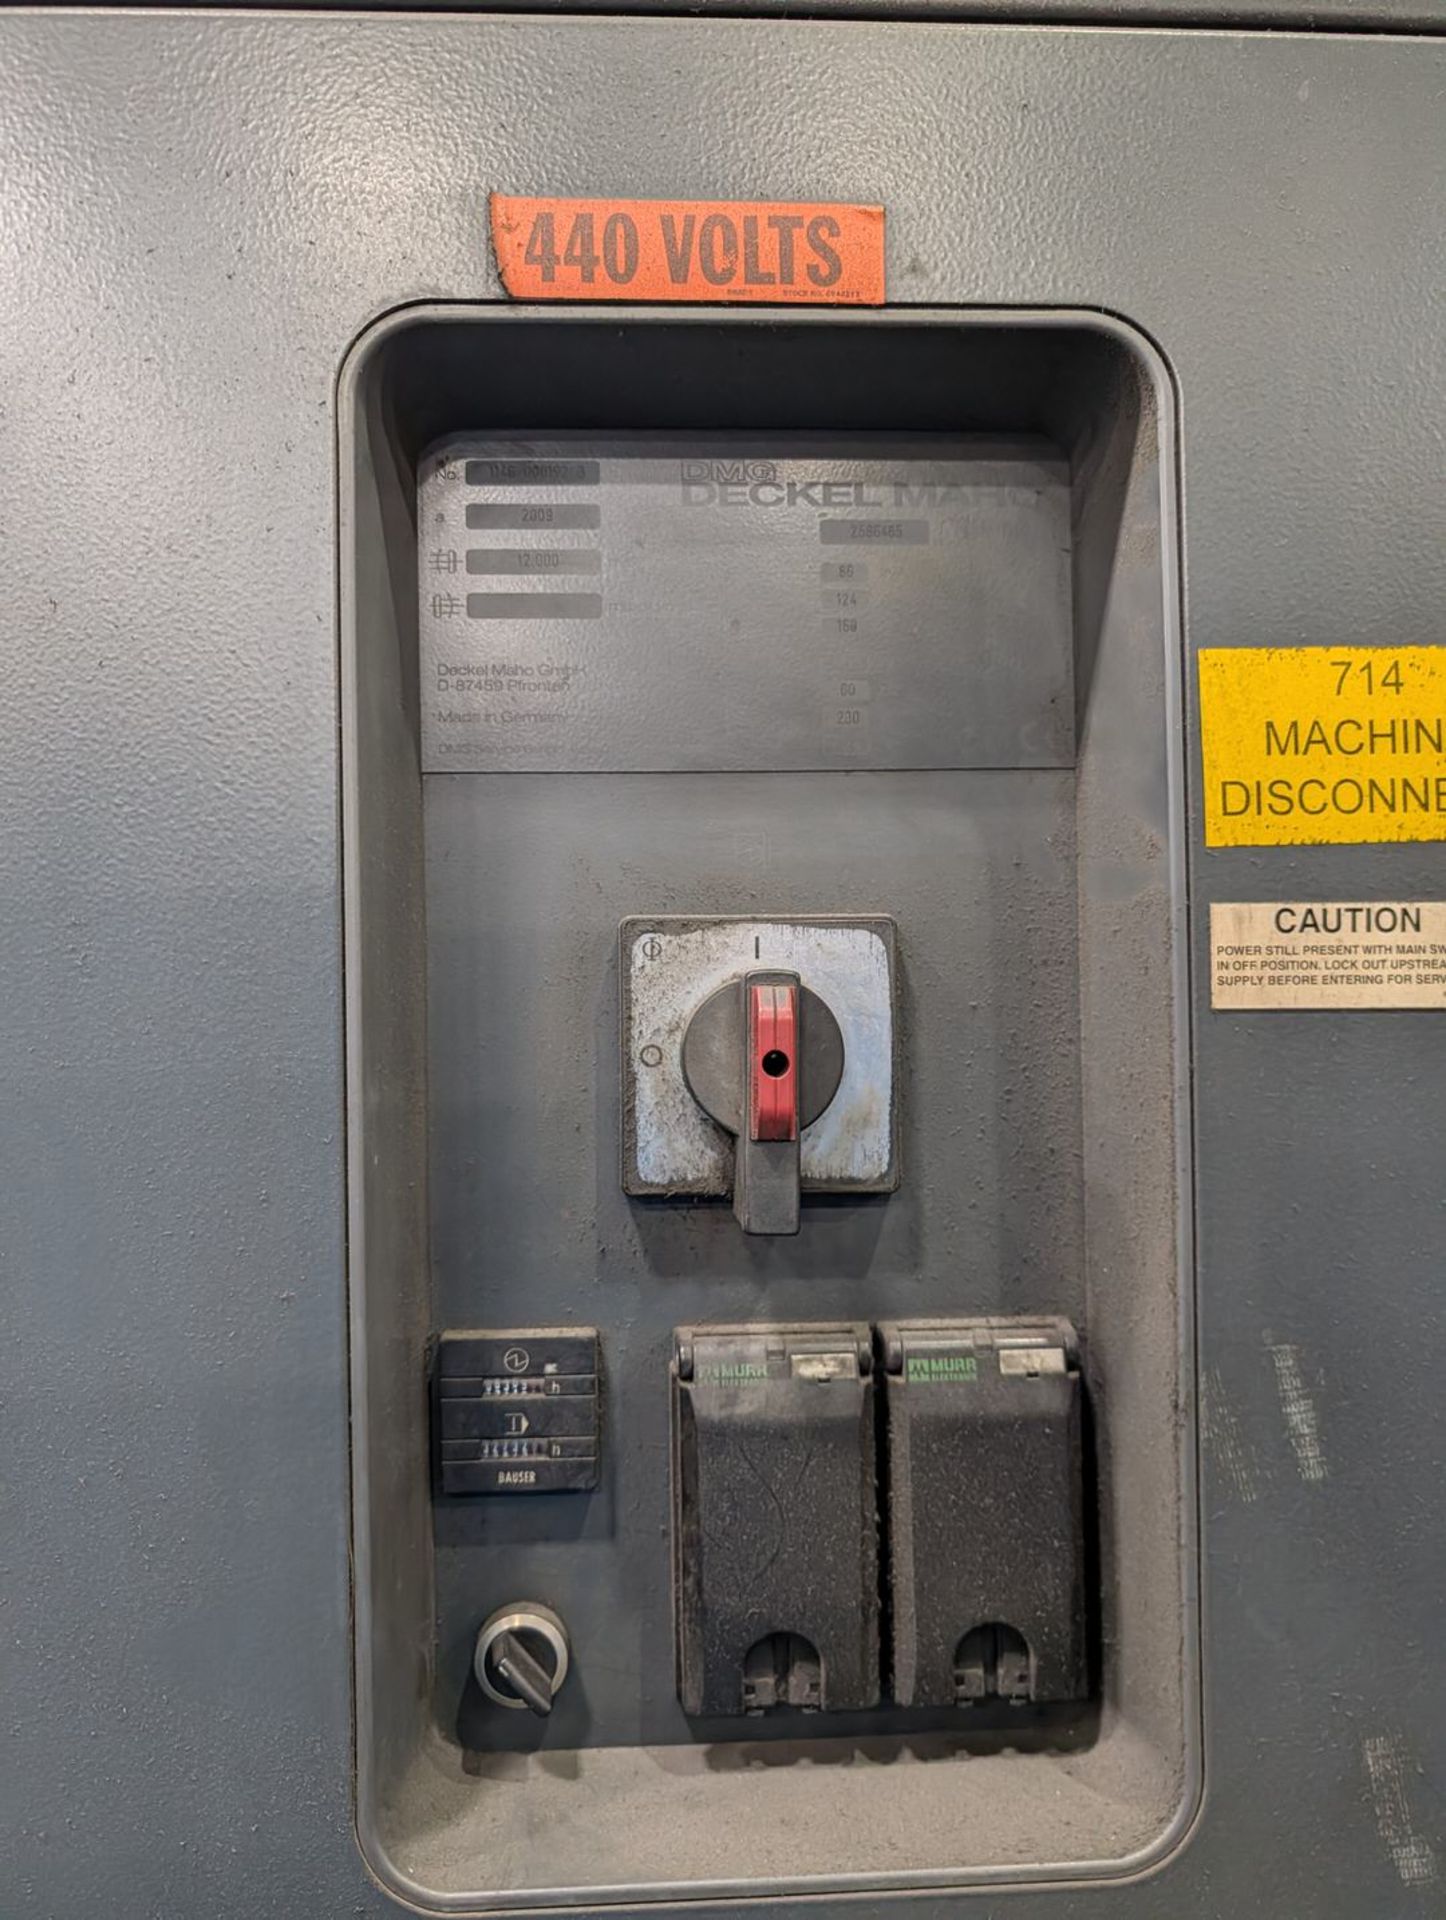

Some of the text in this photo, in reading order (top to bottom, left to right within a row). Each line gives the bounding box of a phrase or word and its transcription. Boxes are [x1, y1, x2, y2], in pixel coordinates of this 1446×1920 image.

[524, 212, 843, 287] 440 VOLTS
[681, 482, 882, 508] DECKEL
[522, 508, 553, 522] 2009
[518, 554, 559, 569] 12.000
[837, 593, 857, 606] 124
[437, 663, 488, 677] Deckel
[491, 663, 535, 677] Maho
[1330, 659, 1404, 697] 714
[437, 679, 503, 692] D-87459
[1274, 907, 1421, 935] CAUTION
[1217, 945, 1262, 957] POWER
[1265, 945, 1299, 957] STILL
[1302, 945, 1359, 957] PRESENT
[1361, 944, 1393, 956] WITH
[1395, 944, 1427, 955] MAIN
[1217, 960, 1229, 972] IN
[1232, 960, 1257, 972] OFF
[1324, 959, 1359, 971] LOCK
[1361, 959, 1388, 970] OUT
[1217, 975, 1264, 987] SUPPLY
[1267, 974, 1319, 986] BEFORE
[1321, 974, 1384, 986] ENTERING
[1386, 973, 1414, 985] FOR
[498, 1470, 537, 1485] BAUSER
